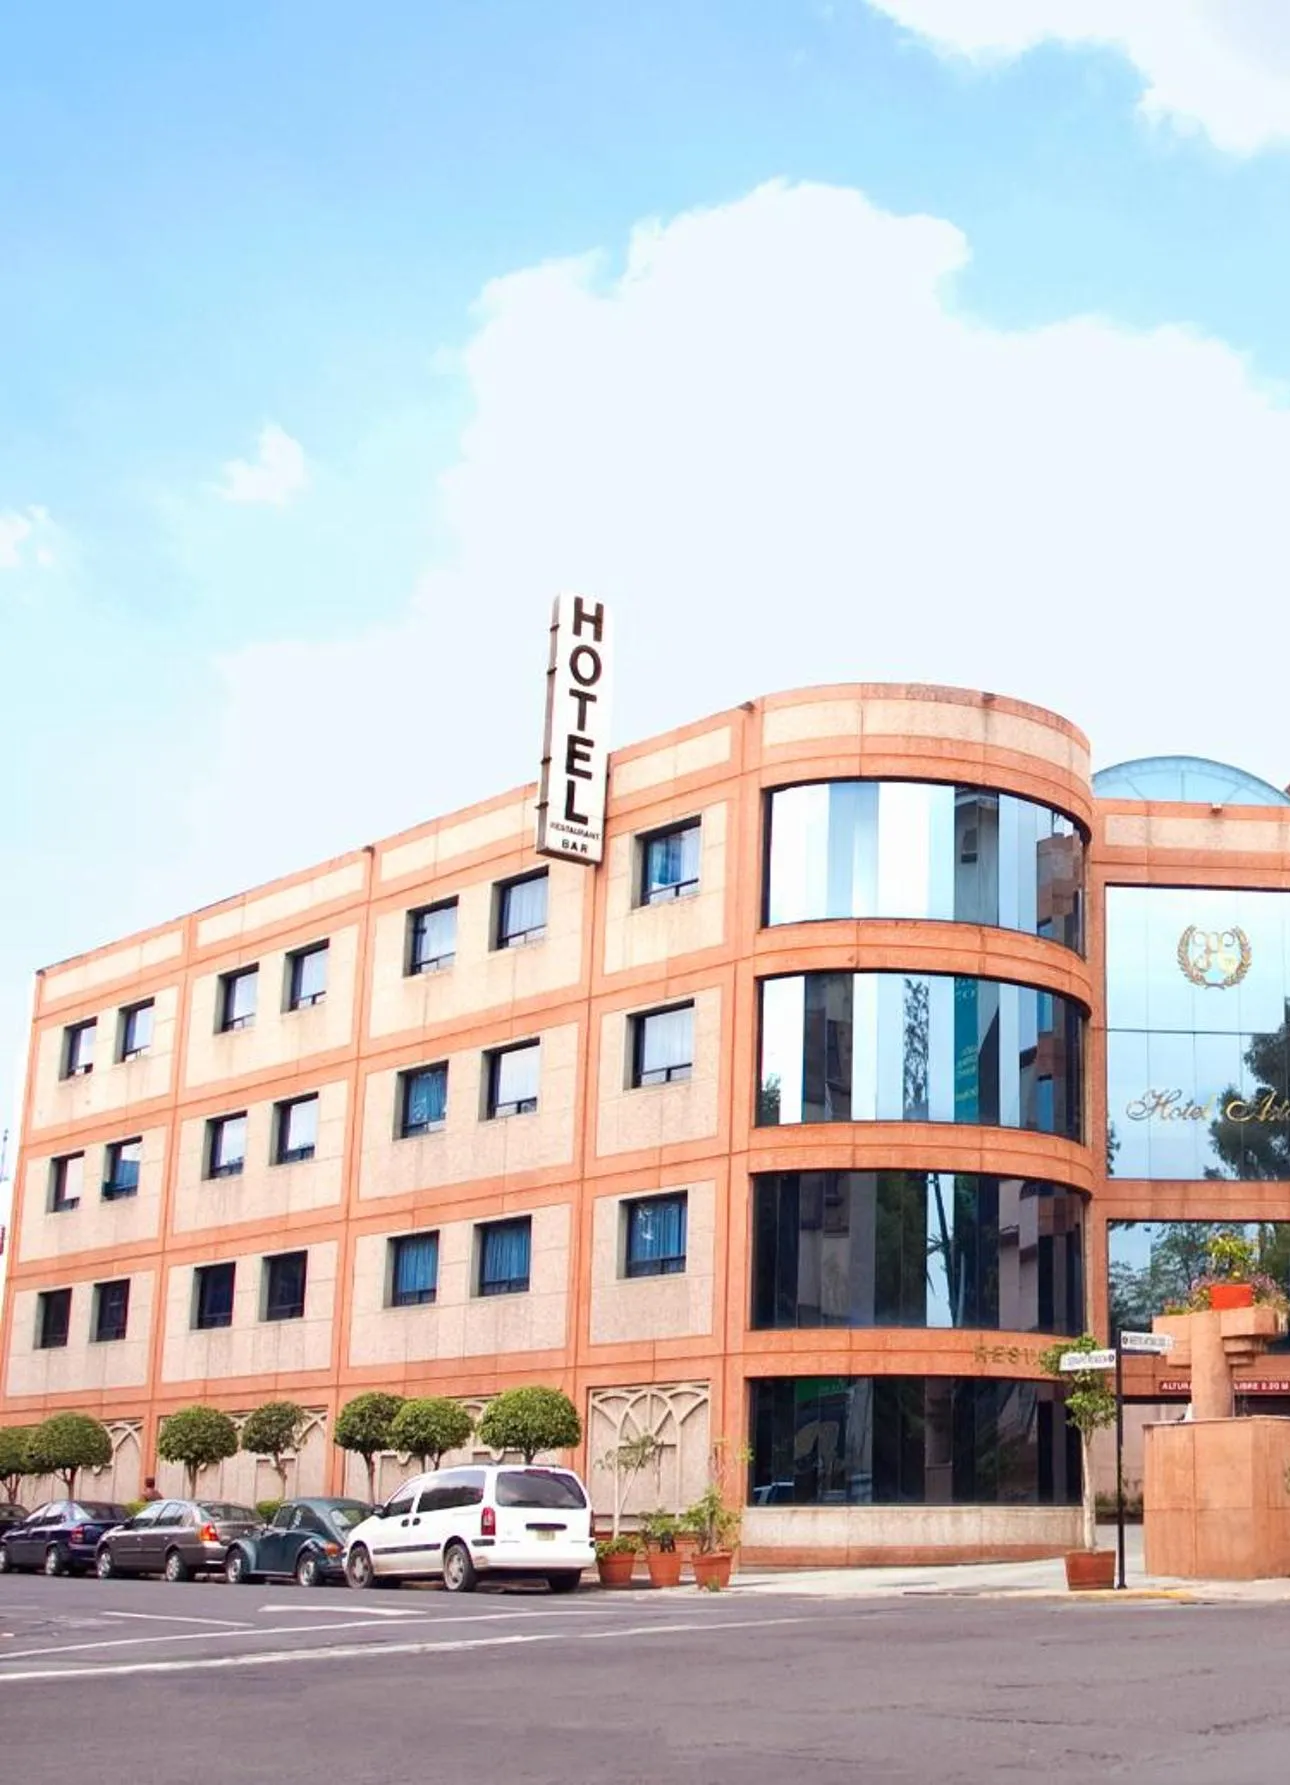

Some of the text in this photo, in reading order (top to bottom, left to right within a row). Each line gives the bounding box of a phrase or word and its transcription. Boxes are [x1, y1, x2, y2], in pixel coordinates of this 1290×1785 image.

[565, 596, 604, 826] HOTEL
[562, 839, 588, 853] BAR
[1126, 1088, 1217, 1121] Hotel
[975, 1345, 1042, 1367] REST
